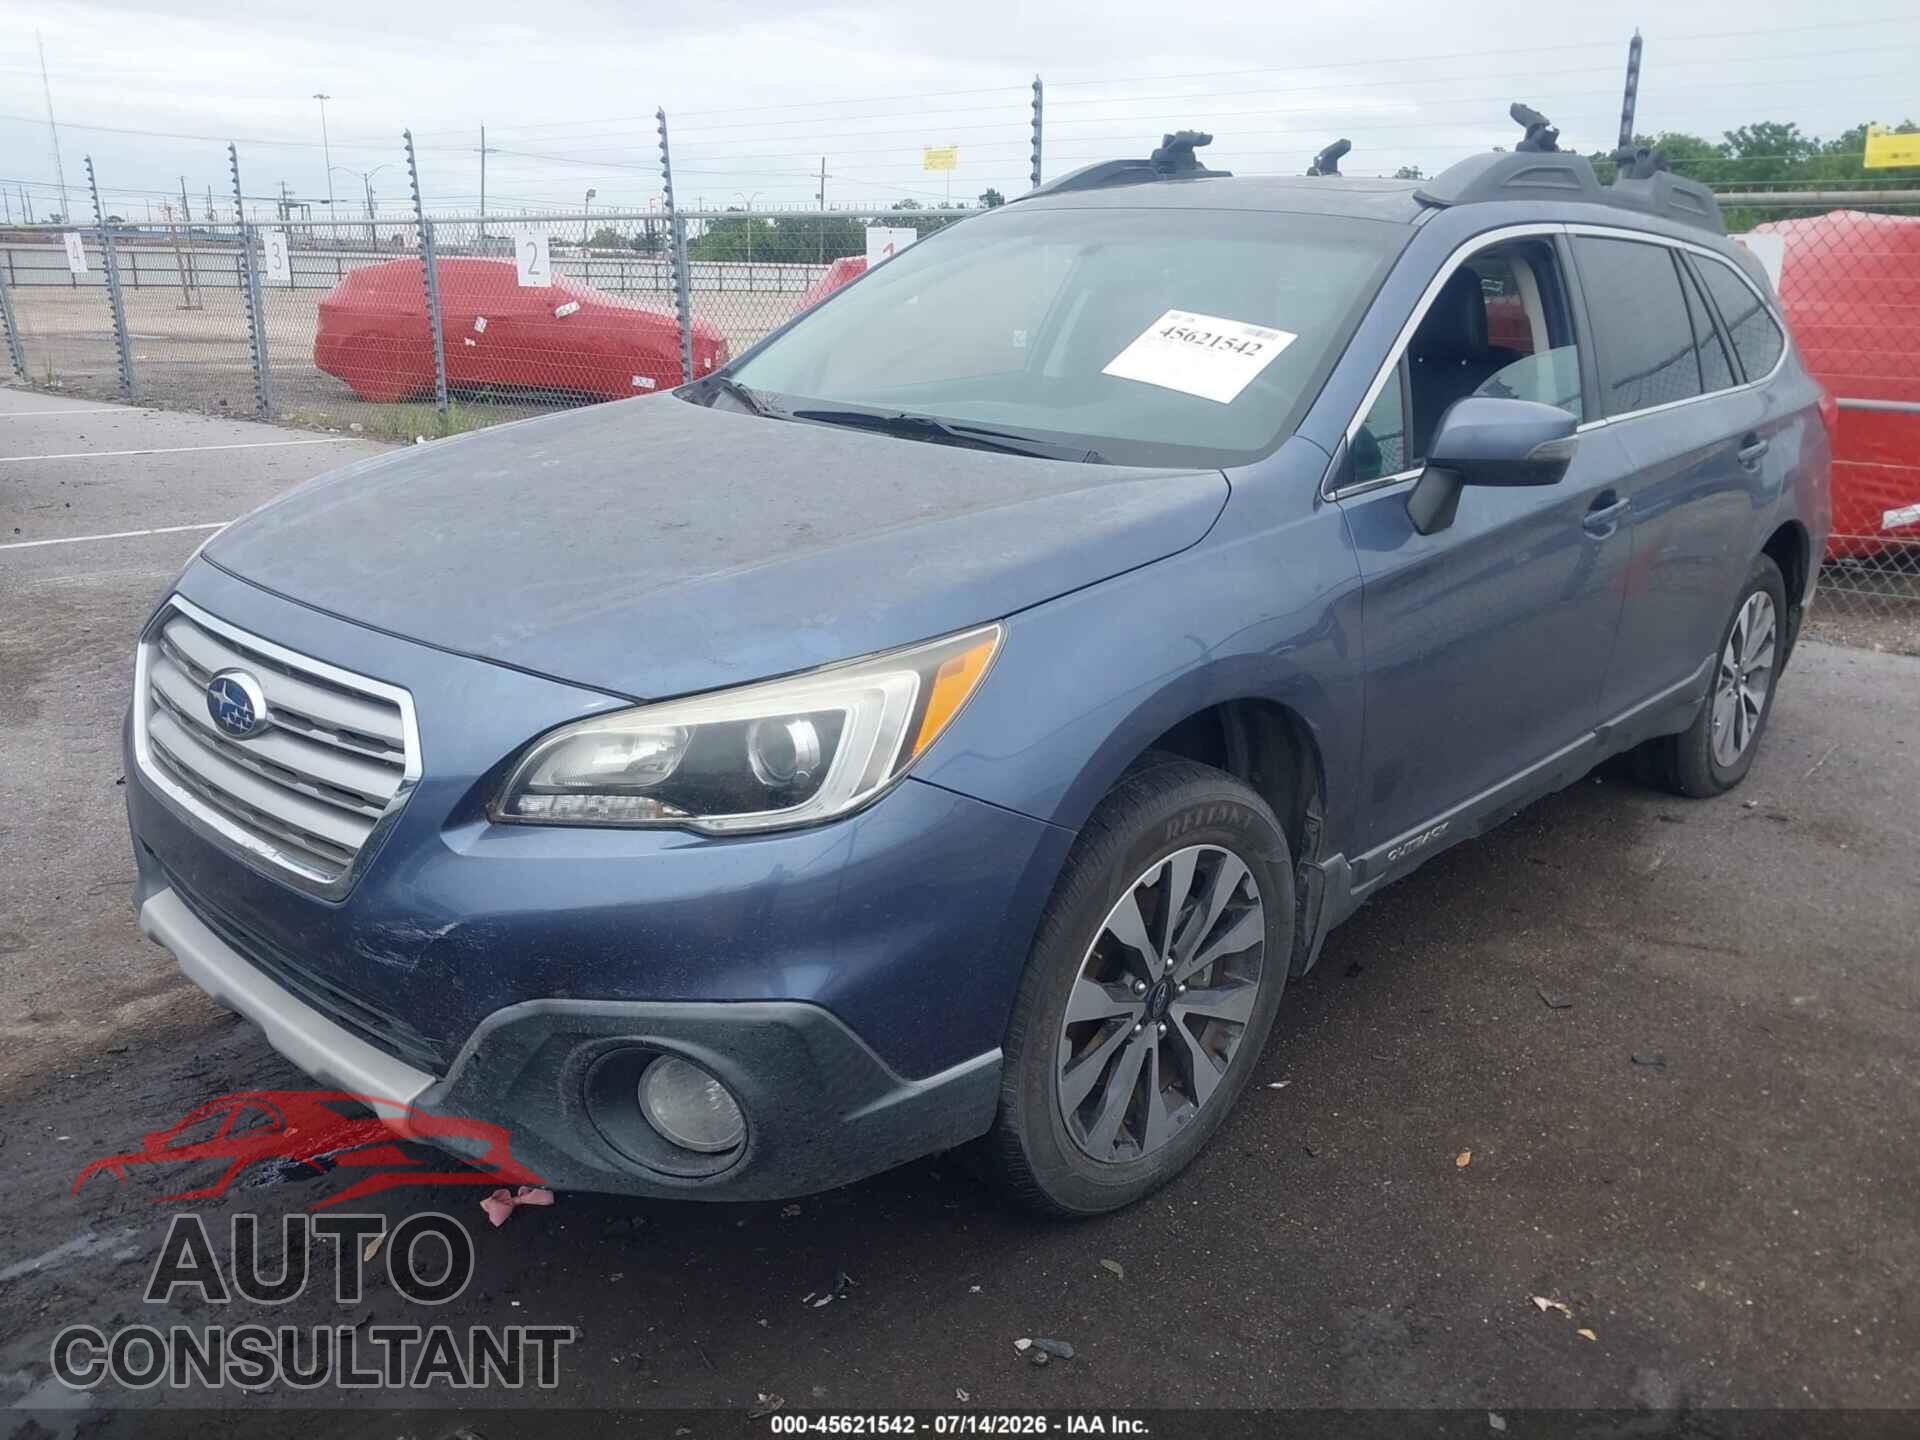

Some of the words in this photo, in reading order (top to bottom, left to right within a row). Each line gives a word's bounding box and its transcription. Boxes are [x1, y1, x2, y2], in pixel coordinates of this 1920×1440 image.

[271, 241, 282, 270] 3
[526, 241, 541, 275] 2
[1160, 326, 1263, 356] 45621542
